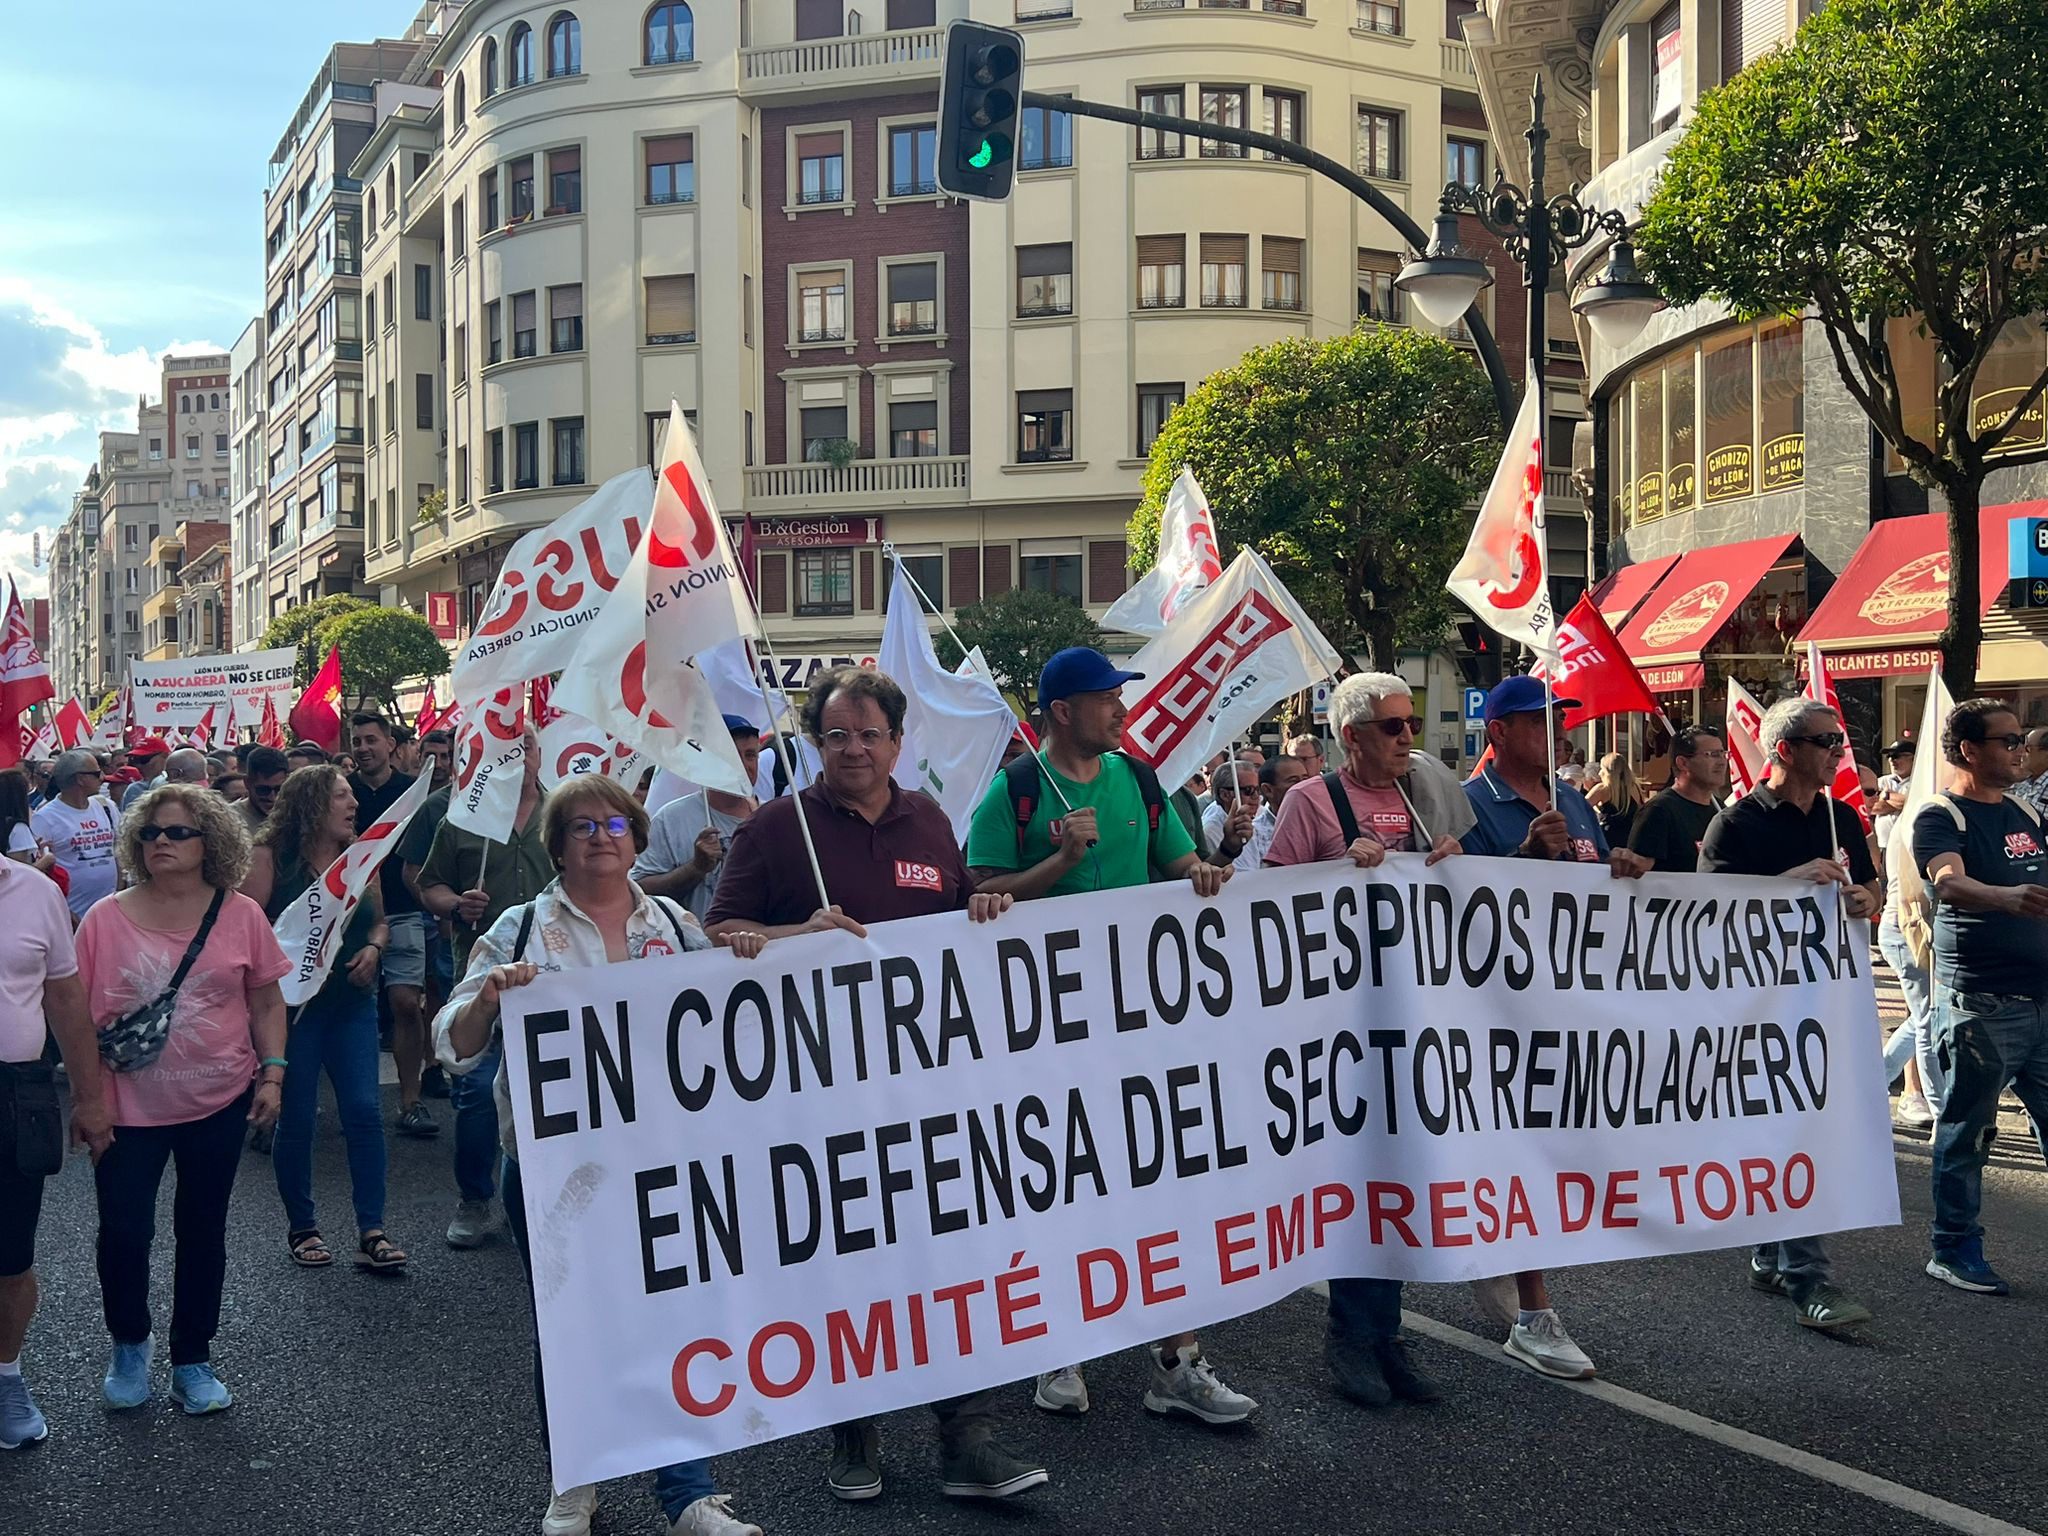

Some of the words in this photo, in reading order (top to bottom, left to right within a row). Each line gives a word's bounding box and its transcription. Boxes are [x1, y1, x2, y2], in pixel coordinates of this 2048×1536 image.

[1980, 409, 2038, 430] CONSAS
[1768, 439, 1804, 460] LENGUA
[1709, 452, 1748, 473] CHORIZO
[1770, 466, 1779, 476] DE
[1780, 457, 1802, 473] VACA
[1713, 477, 1722, 487] DE
[1723, 468, 1744, 484] LEÓN
[776, 536, 833, 546] ASESORÍA
[1867, 594, 1948, 611] ENTREPEÑA
[223, 663, 250, 673] GUERRA
[1800, 653, 1889, 673] FRICANTES
[1893, 650, 1939, 668] DESDE
[134, 677, 151, 687] LA
[152, 674, 226, 688] AZUCARERA
[229, 672, 247, 684] NO
[249, 671, 263, 682] SE
[266, 666, 296, 681] CIERR
[1127, 601, 1272, 758] CCOO
[1648, 672, 1660, 685] DE
[1661, 667, 1684, 684] LEÓN
[232, 688, 250, 696] LASE
[1207, 673, 1259, 724] León
[1469, 691, 1483, 716] P
[80, 820, 98, 830] NO
[1373, 814, 1408, 823] CCOO
[298, 926, 322, 984] OBRERA
[523, 1001, 636, 1140] EN
[666, 947, 984, 1112] CONTRA
[996, 928, 1089, 1053] DE
[1108, 906, 1233, 1034] LOS
[1250, 882, 1535, 1008] DESPIDOS
[1549, 891, 1610, 990] DE
[1616, 886, 1859, 991] AZUCARERA
[634, 1153, 744, 1295] EN
[769, 1087, 1108, 1268] DEFENSA
[1120, 1062, 1248, 1189] DEL
[1264, 1026, 1481, 1157] SECTOR
[1489, 1017, 1829, 1130] REMOLACHERO
[671, 1249, 1049, 1418] COMITÉ
[1076, 1230, 1188, 1323] DE
[1214, 1174, 1539, 1286] EMPRESA
[1556, 1169, 1640, 1233] DE
[1659, 1152, 1816, 1226] TORO
